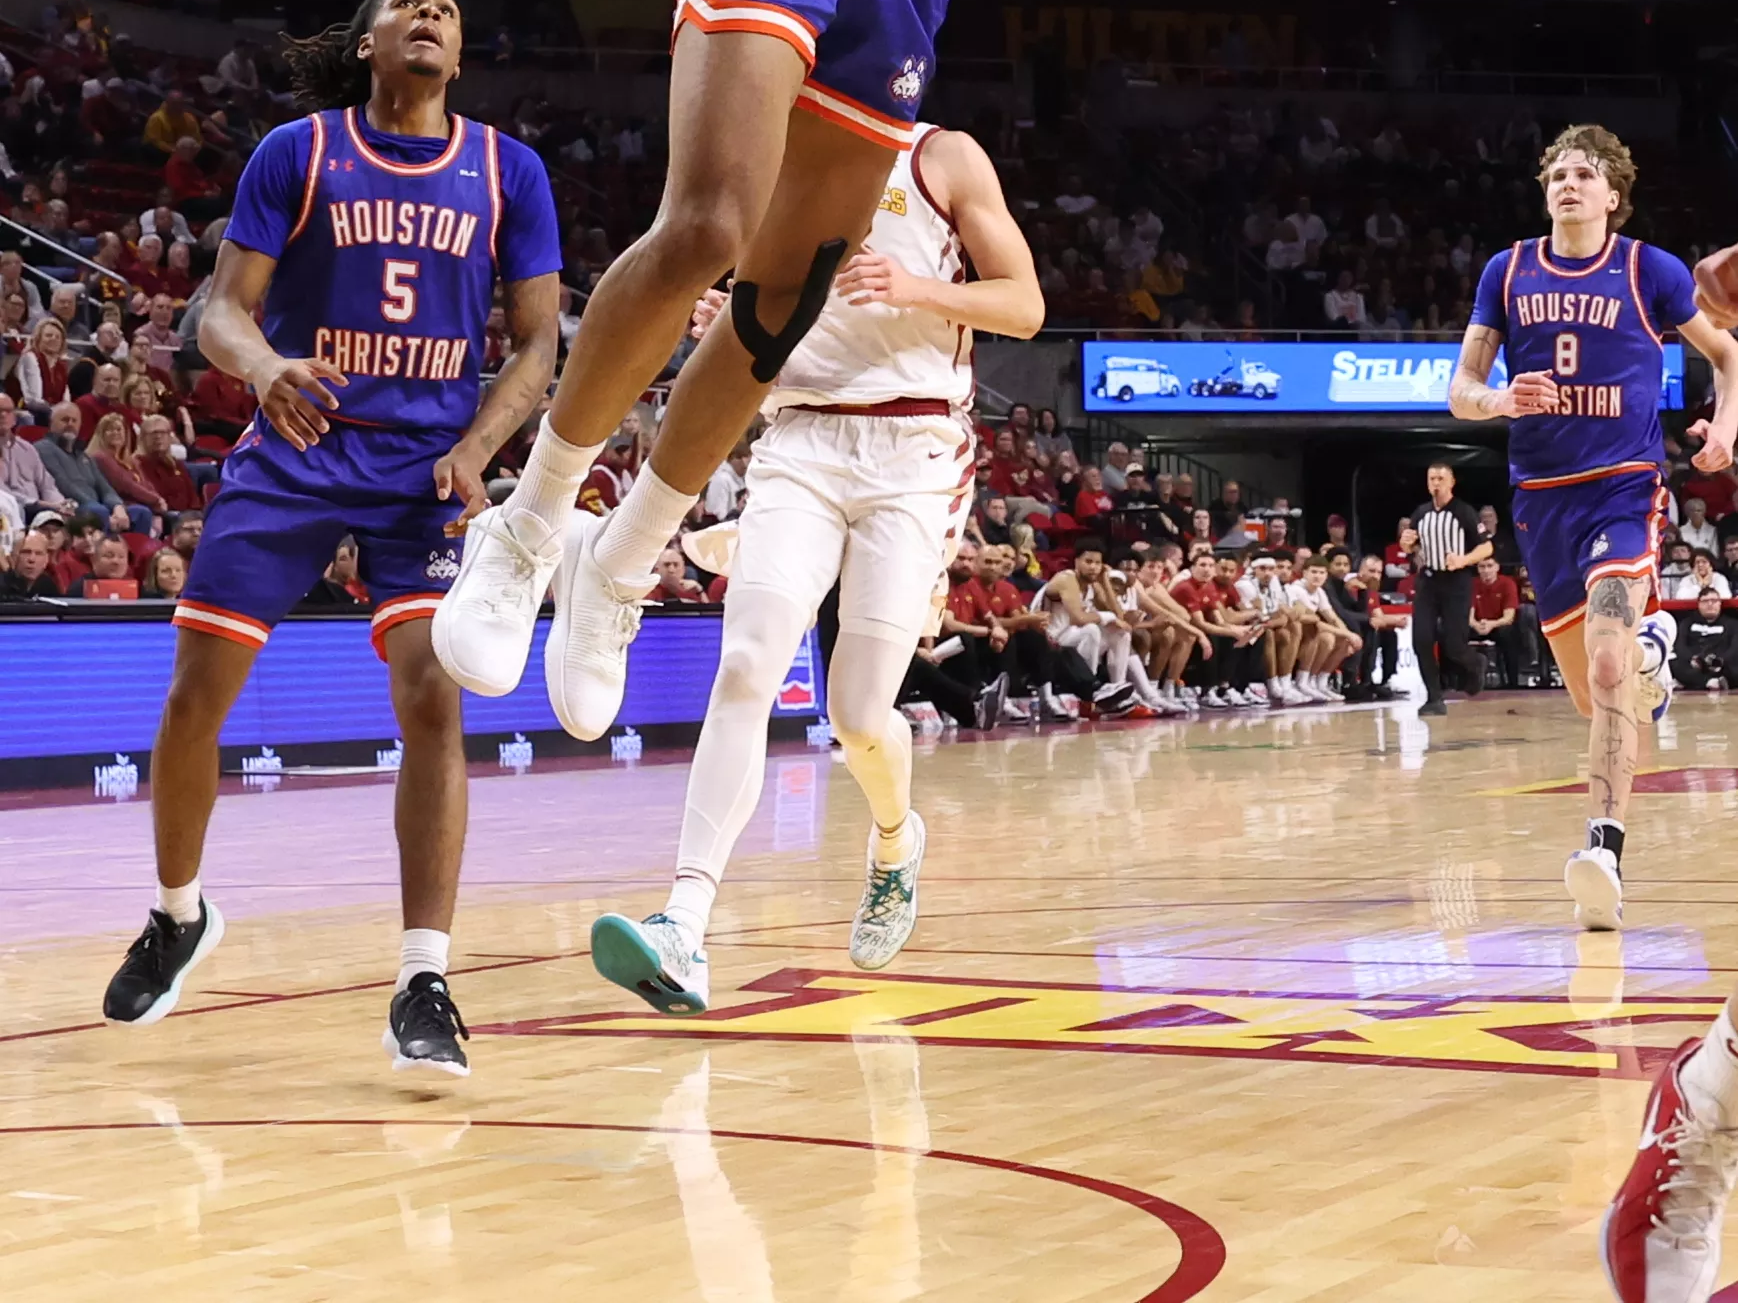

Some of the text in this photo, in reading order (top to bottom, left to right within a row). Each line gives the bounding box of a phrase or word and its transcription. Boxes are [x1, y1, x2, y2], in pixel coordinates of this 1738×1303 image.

[329, 199, 480, 259] HOUSTON
[380, 258, 420, 324] 5
[1515, 292, 1622, 330] HOUSTON
[315, 326, 469, 381] CHRISTIAN
[1554, 332, 1580, 377] 8
